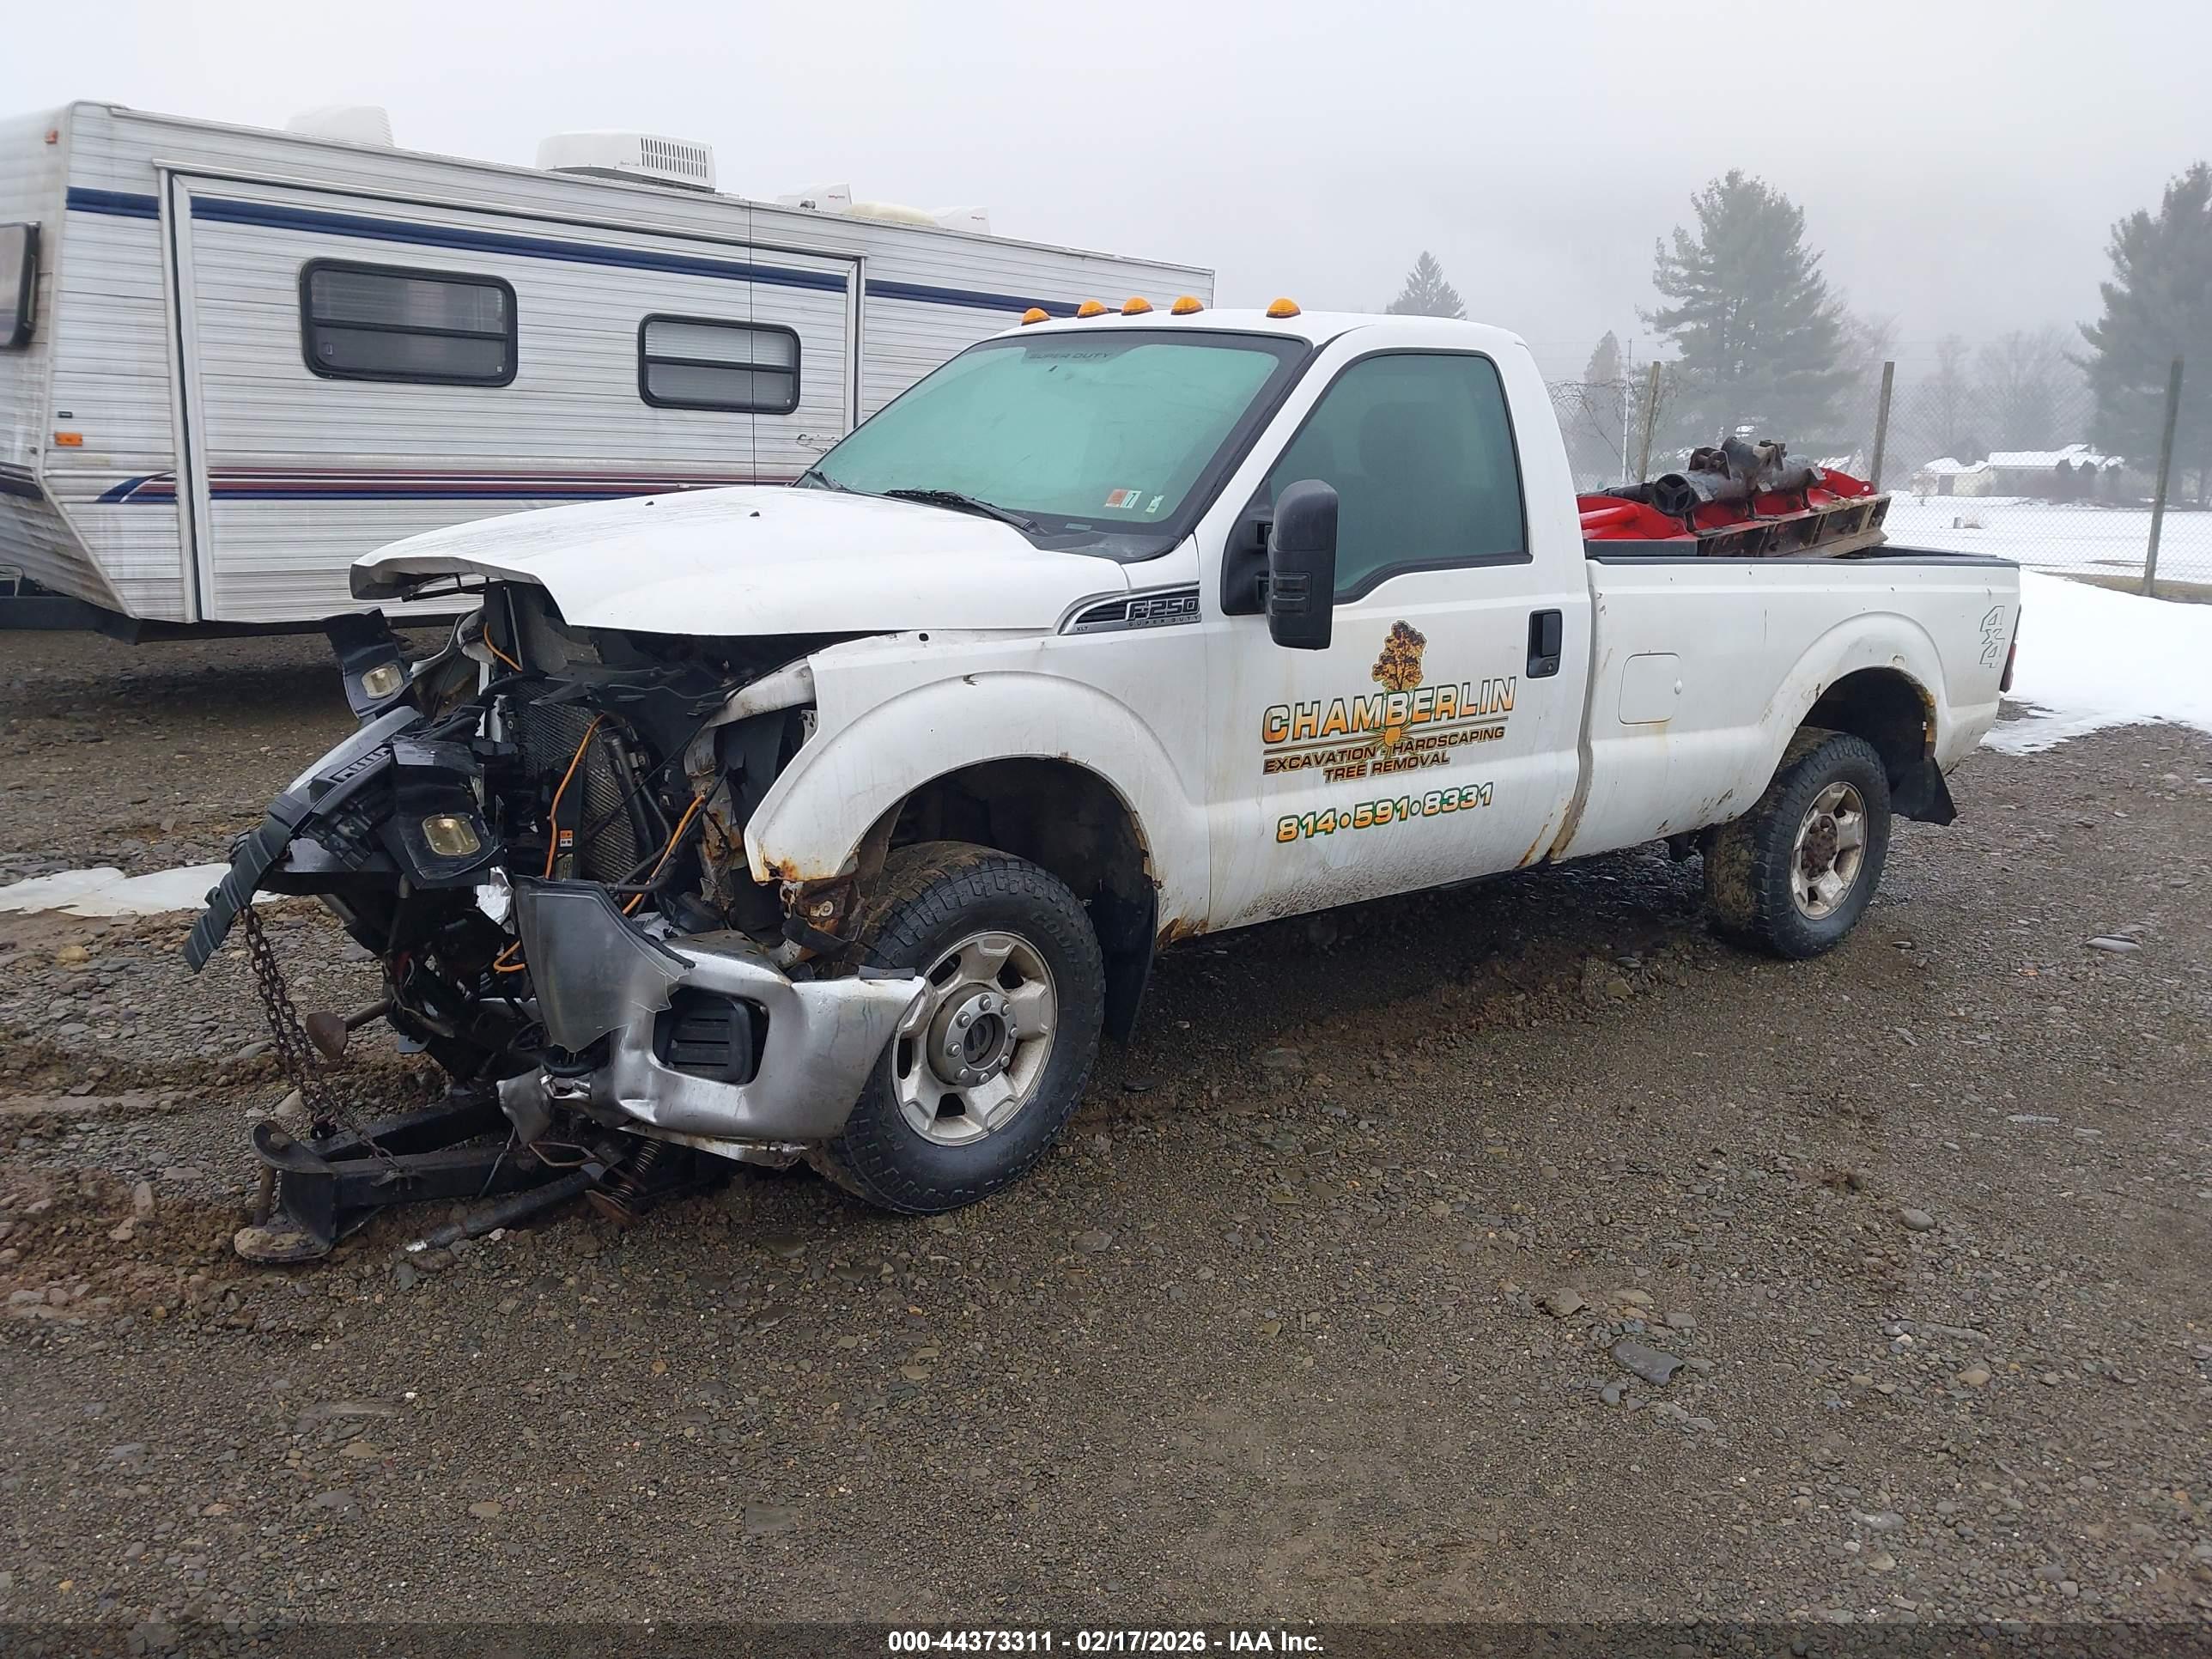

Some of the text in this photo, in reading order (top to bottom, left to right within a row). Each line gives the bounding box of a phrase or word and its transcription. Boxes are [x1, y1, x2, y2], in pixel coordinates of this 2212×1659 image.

[1261, 677, 1516, 744] CHAMBERLIN
[1262, 745, 1376, 775] EXCAVATION
[1323, 752, 1450, 783] TREE REMOVAL
